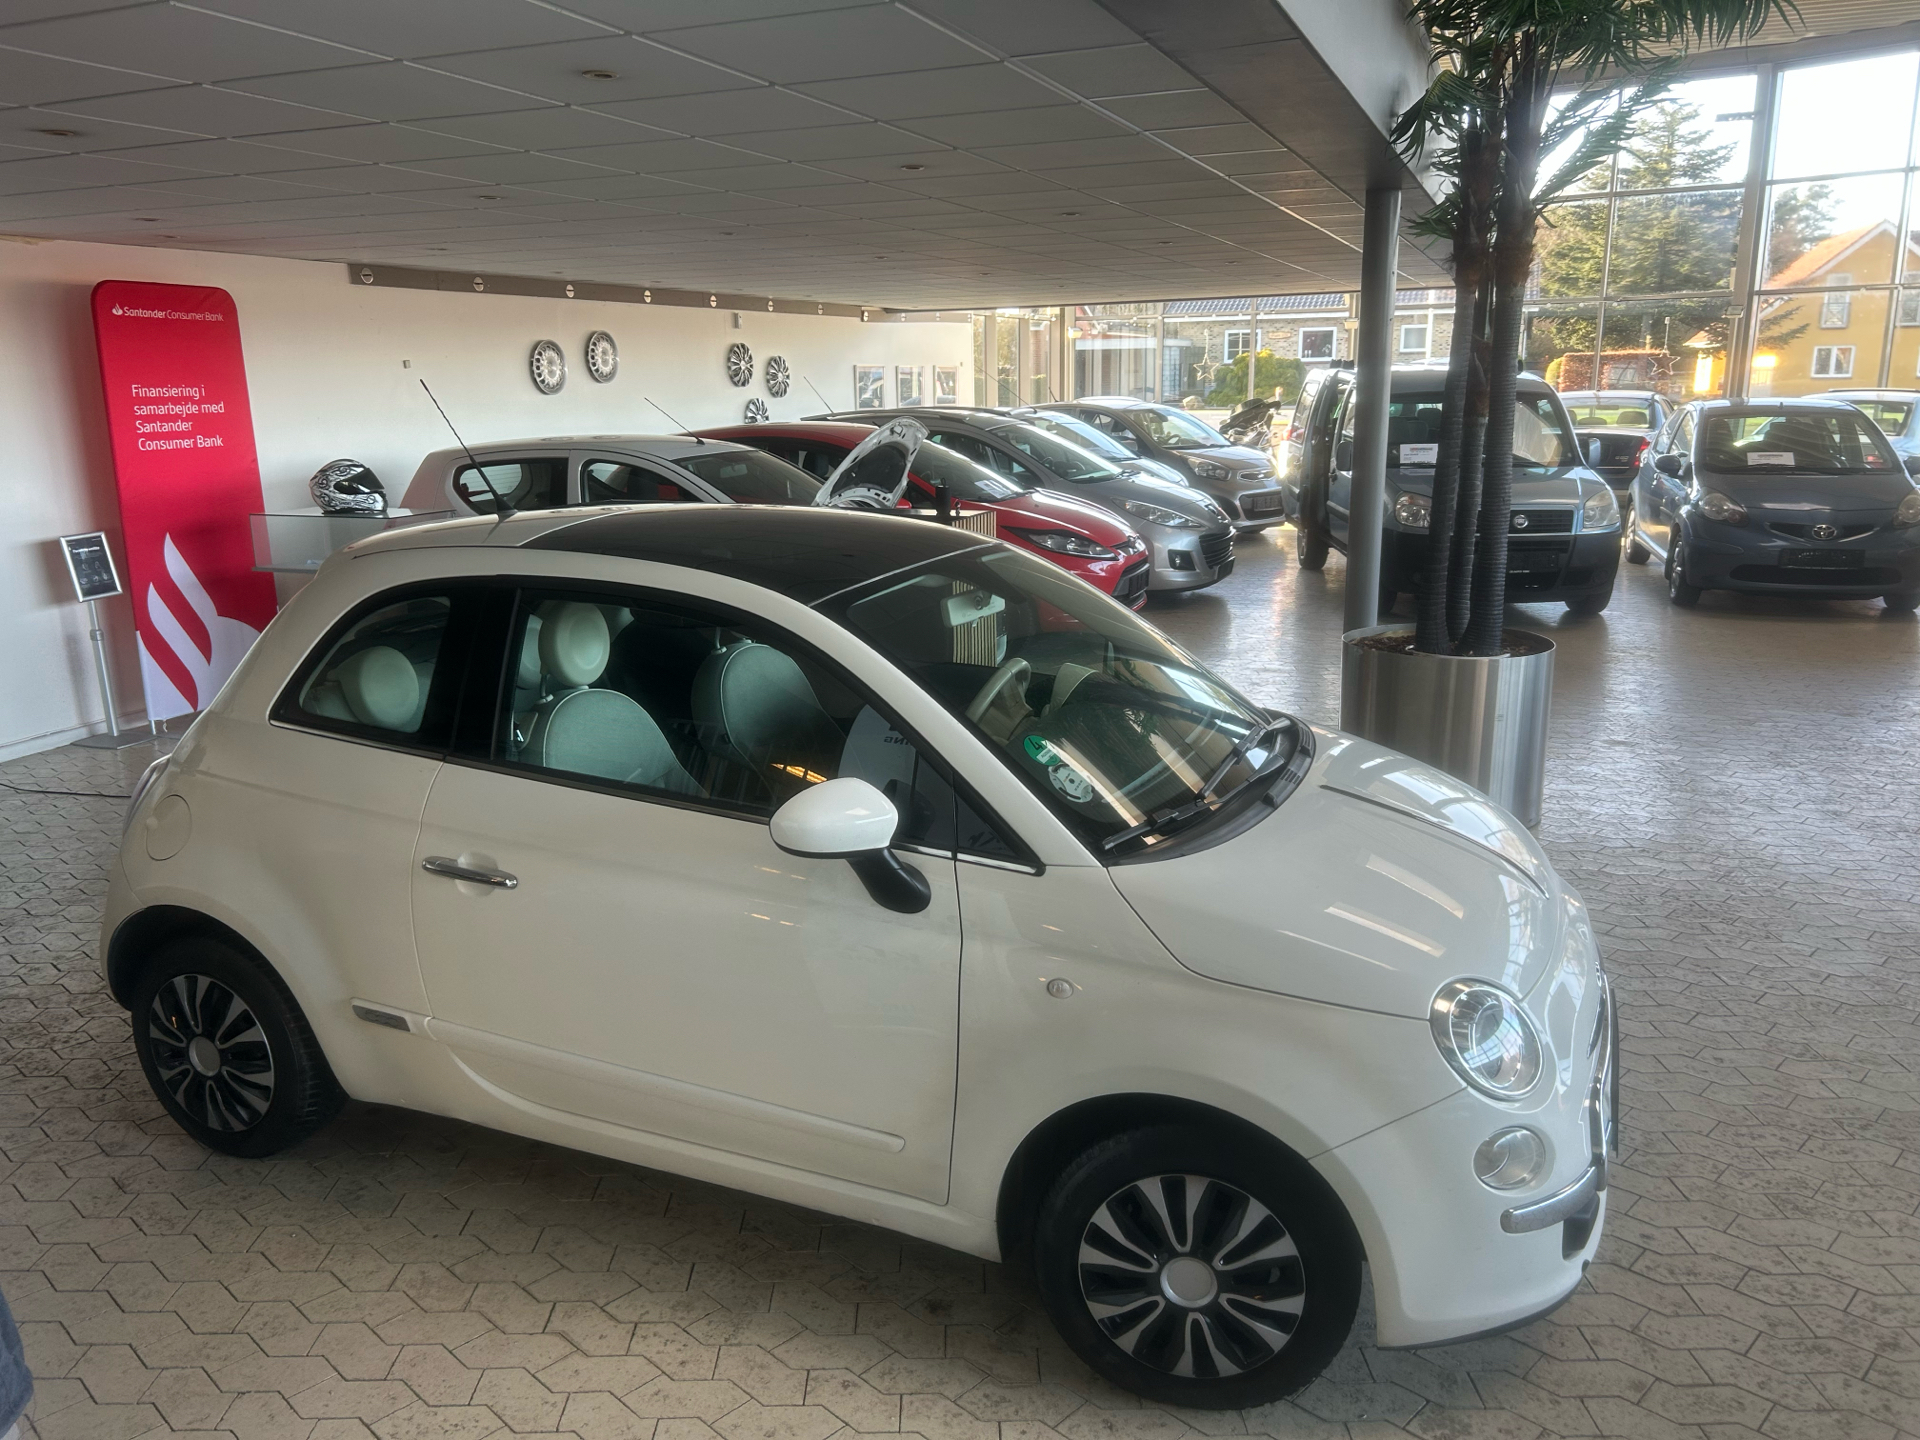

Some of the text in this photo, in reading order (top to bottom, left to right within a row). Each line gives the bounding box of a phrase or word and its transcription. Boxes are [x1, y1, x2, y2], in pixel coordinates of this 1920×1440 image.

[123, 306, 224, 322] Santander Consumer Bank
[131, 384, 206, 400] Finansiering i
[133, 401, 225, 418] samarbejde med
[135, 419, 193, 433] Santander
[138, 434, 224, 451] Consumer Bank
